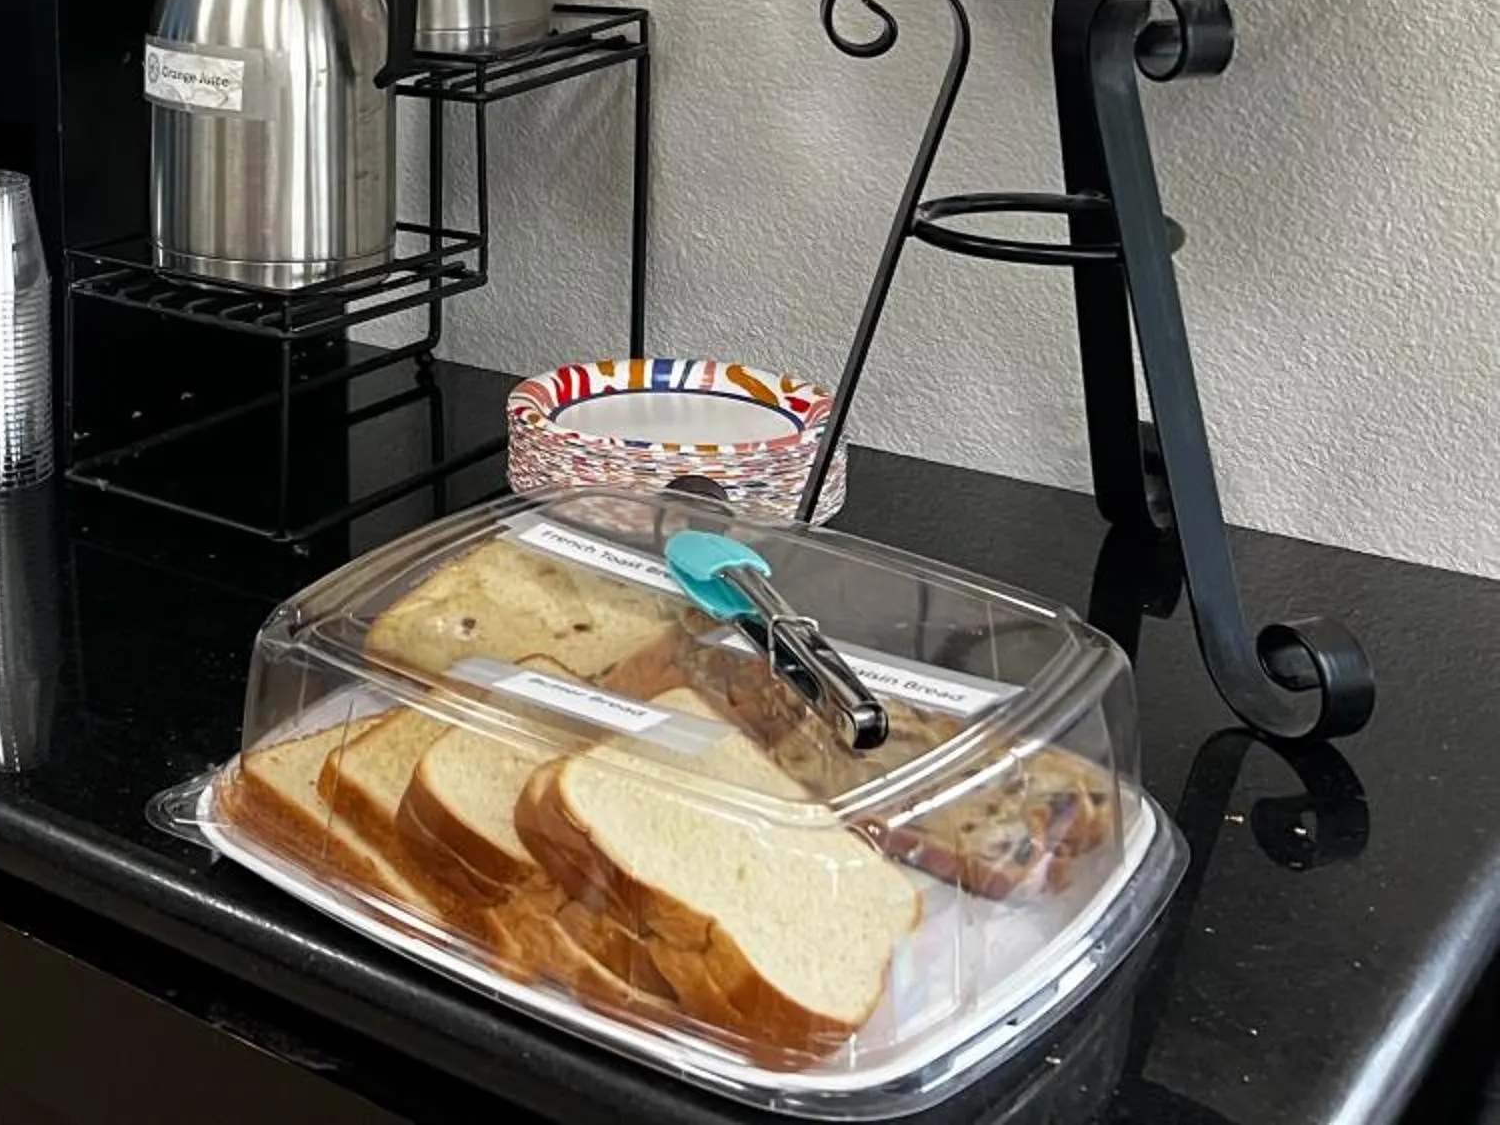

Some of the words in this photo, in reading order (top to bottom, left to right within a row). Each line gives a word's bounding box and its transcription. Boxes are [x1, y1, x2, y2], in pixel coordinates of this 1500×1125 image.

[161, 65, 197, 84] Orange
[199, 71, 230, 87] Juice
[541, 530, 597, 554] French
[599, 550, 643, 570] Toast
[645, 565, 674, 580] Bre
[903, 681, 966, 703] Bread
